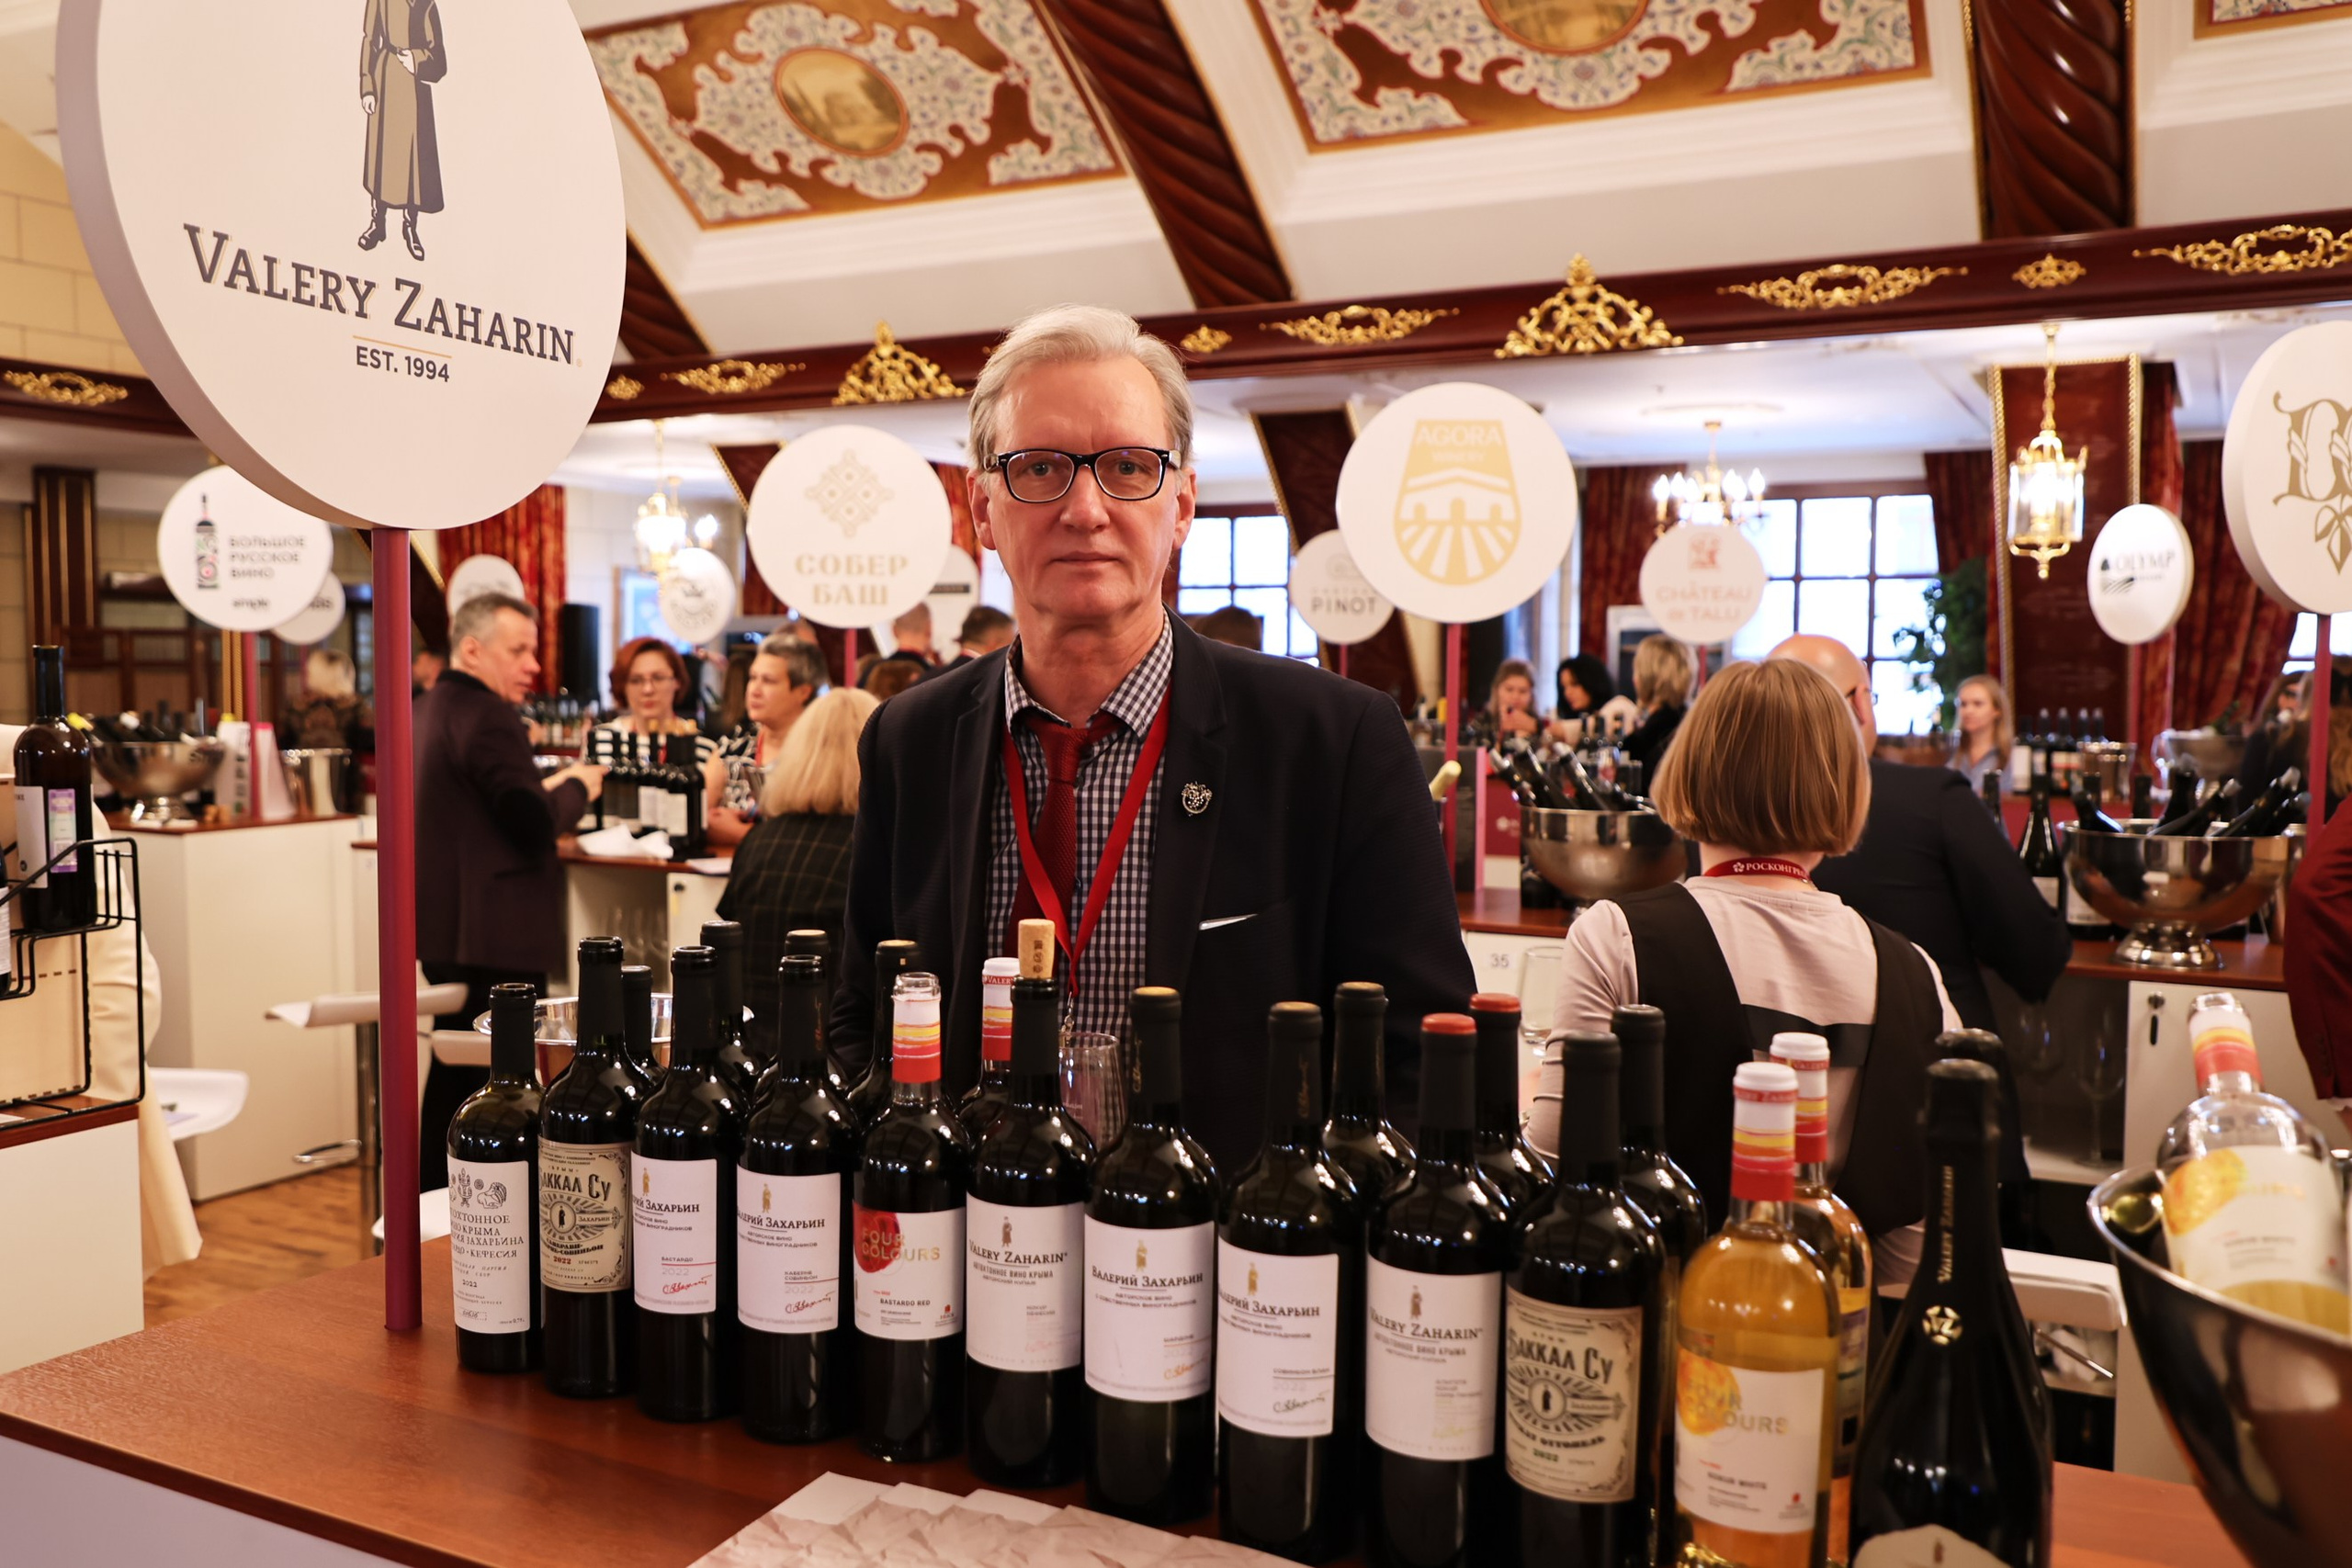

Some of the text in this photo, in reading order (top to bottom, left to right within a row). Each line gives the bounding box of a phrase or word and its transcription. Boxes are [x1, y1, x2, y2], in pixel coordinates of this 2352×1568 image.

[184, 222, 576, 365] VALERY ZAHARIN
[356, 344, 450, 382] EST. 1994
[1417, 424, 1503, 446] AGORA
[795, 554, 908, 577] СОБЕР
[813, 583, 889, 605] БАШ
[1311, 596, 1376, 615] PINOT
[1490, 953, 1510, 969] 35
[988, 976, 1012, 985] VALER
[453, 1210, 510, 1224] ОХТОННОЕ
[765, 1217, 825, 1229] ЗАХАРЬИН
[462, 1225, 501, 1236] КРЫМА
[470, 1249, 517, 1258] КЕФЕСИЯ
[862, 1242, 941, 1261] COLOURS
[553, 1255, 571, 1265] 2022
[1091, 1265, 1204, 1288] ВАЛЕРИЙ ЗАХАРЬИН
[880, 1298, 915, 1306] BASTARDO
[1252, 1301, 1319, 1316] ЗАХАРЬИН
